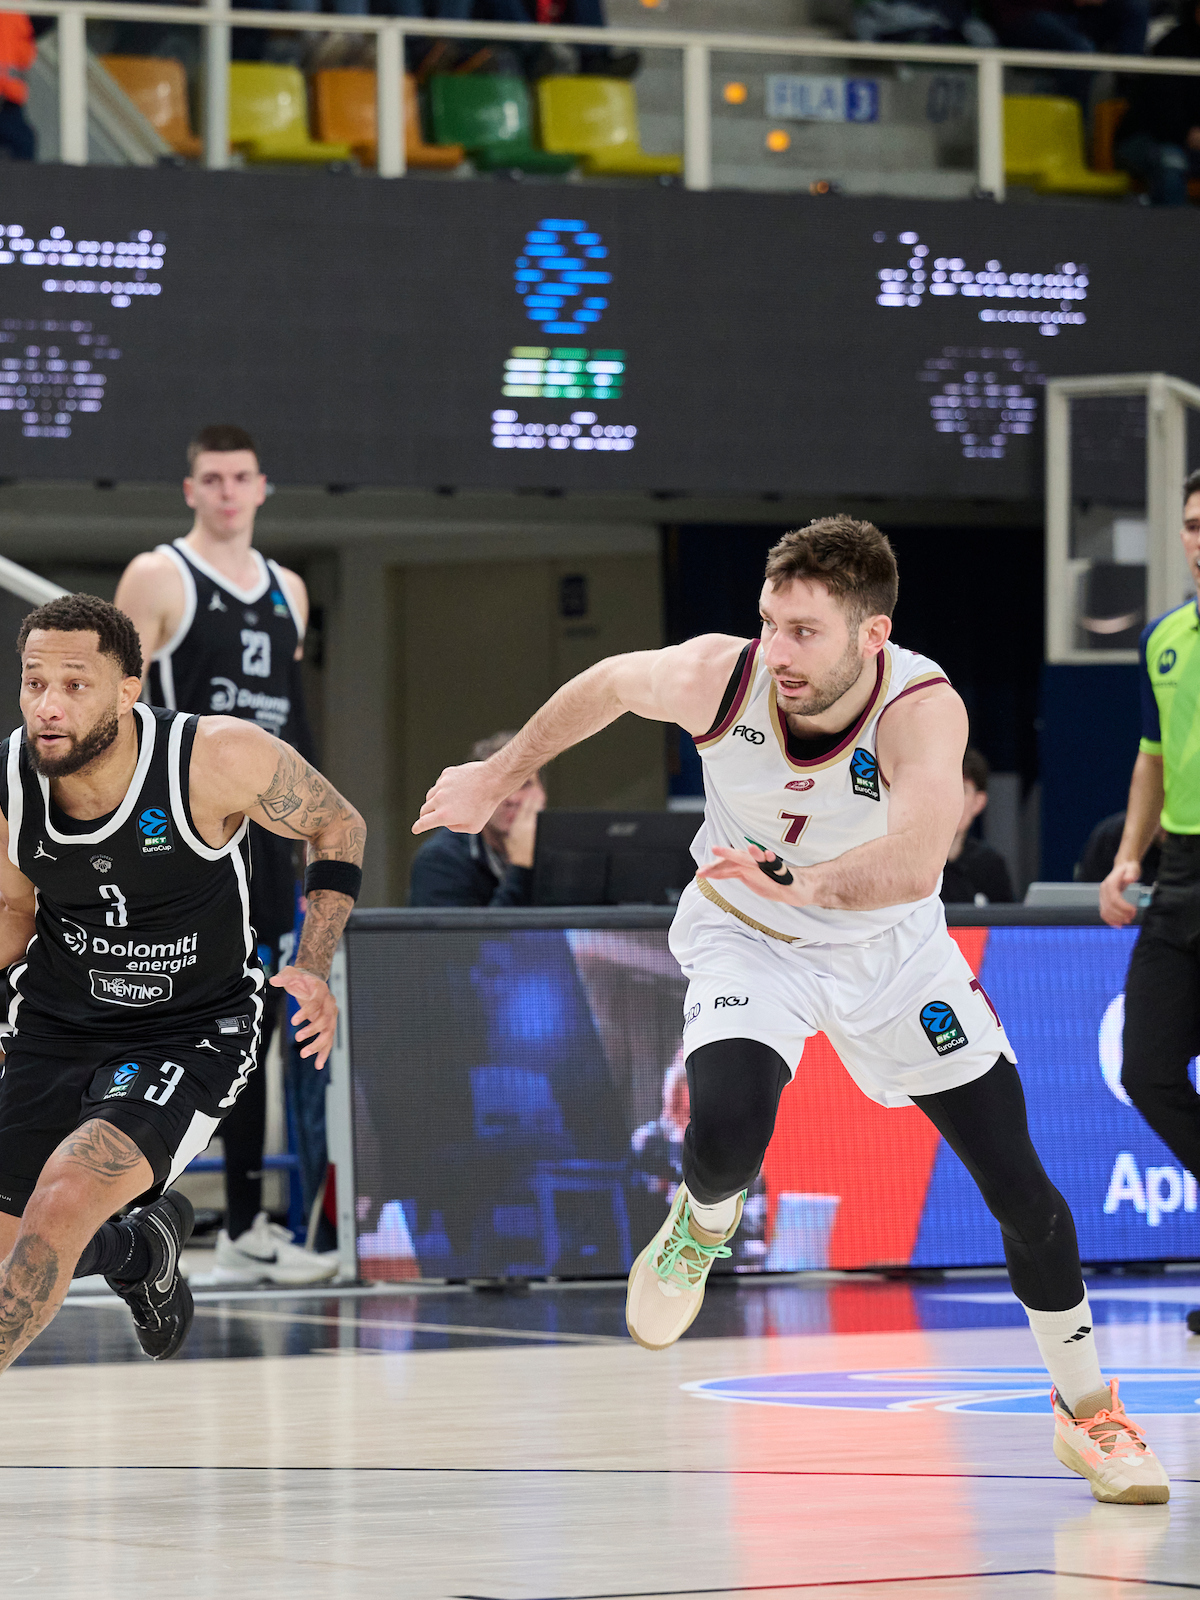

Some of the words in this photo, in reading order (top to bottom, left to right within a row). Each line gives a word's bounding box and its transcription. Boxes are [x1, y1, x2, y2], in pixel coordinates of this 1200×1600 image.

[240, 629, 272, 678] 23
[854, 784, 879, 799] EuroCup
[778, 810, 812, 846] 7
[142, 844, 172, 854] EuroCup
[144, 836, 168, 847] BKT
[98, 883, 129, 928] 3
[92, 932, 198, 958] Dolomiti
[126, 954, 197, 974] energia
[98, 977, 164, 1000] TRENTINO
[935, 1028, 958, 1045] BKT
[936, 1036, 966, 1053] EuroCup
[143, 1060, 186, 1107] 3
